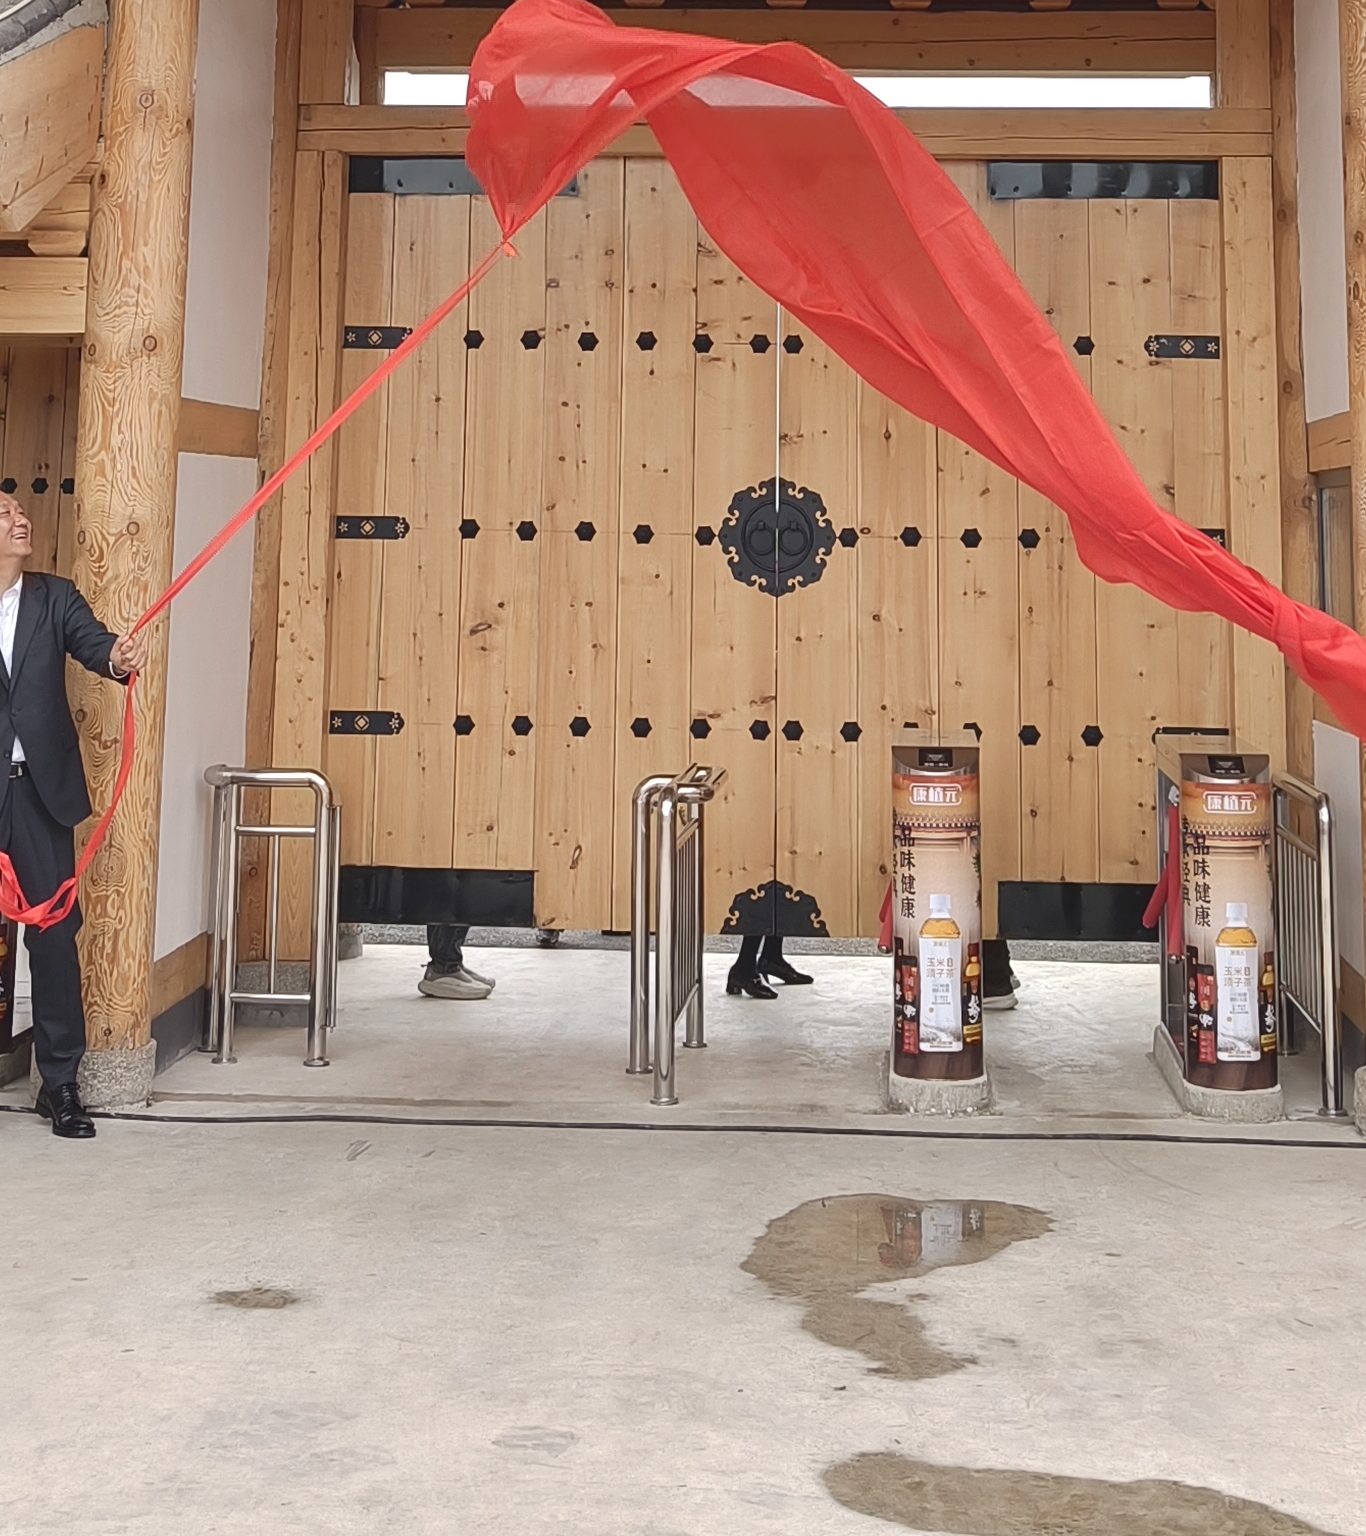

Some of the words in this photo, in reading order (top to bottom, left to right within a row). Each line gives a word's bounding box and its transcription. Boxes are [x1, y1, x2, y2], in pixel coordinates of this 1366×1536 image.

[899, 825, 916, 919] 品味健康
[1192, 834, 1212, 928] 品味健康
